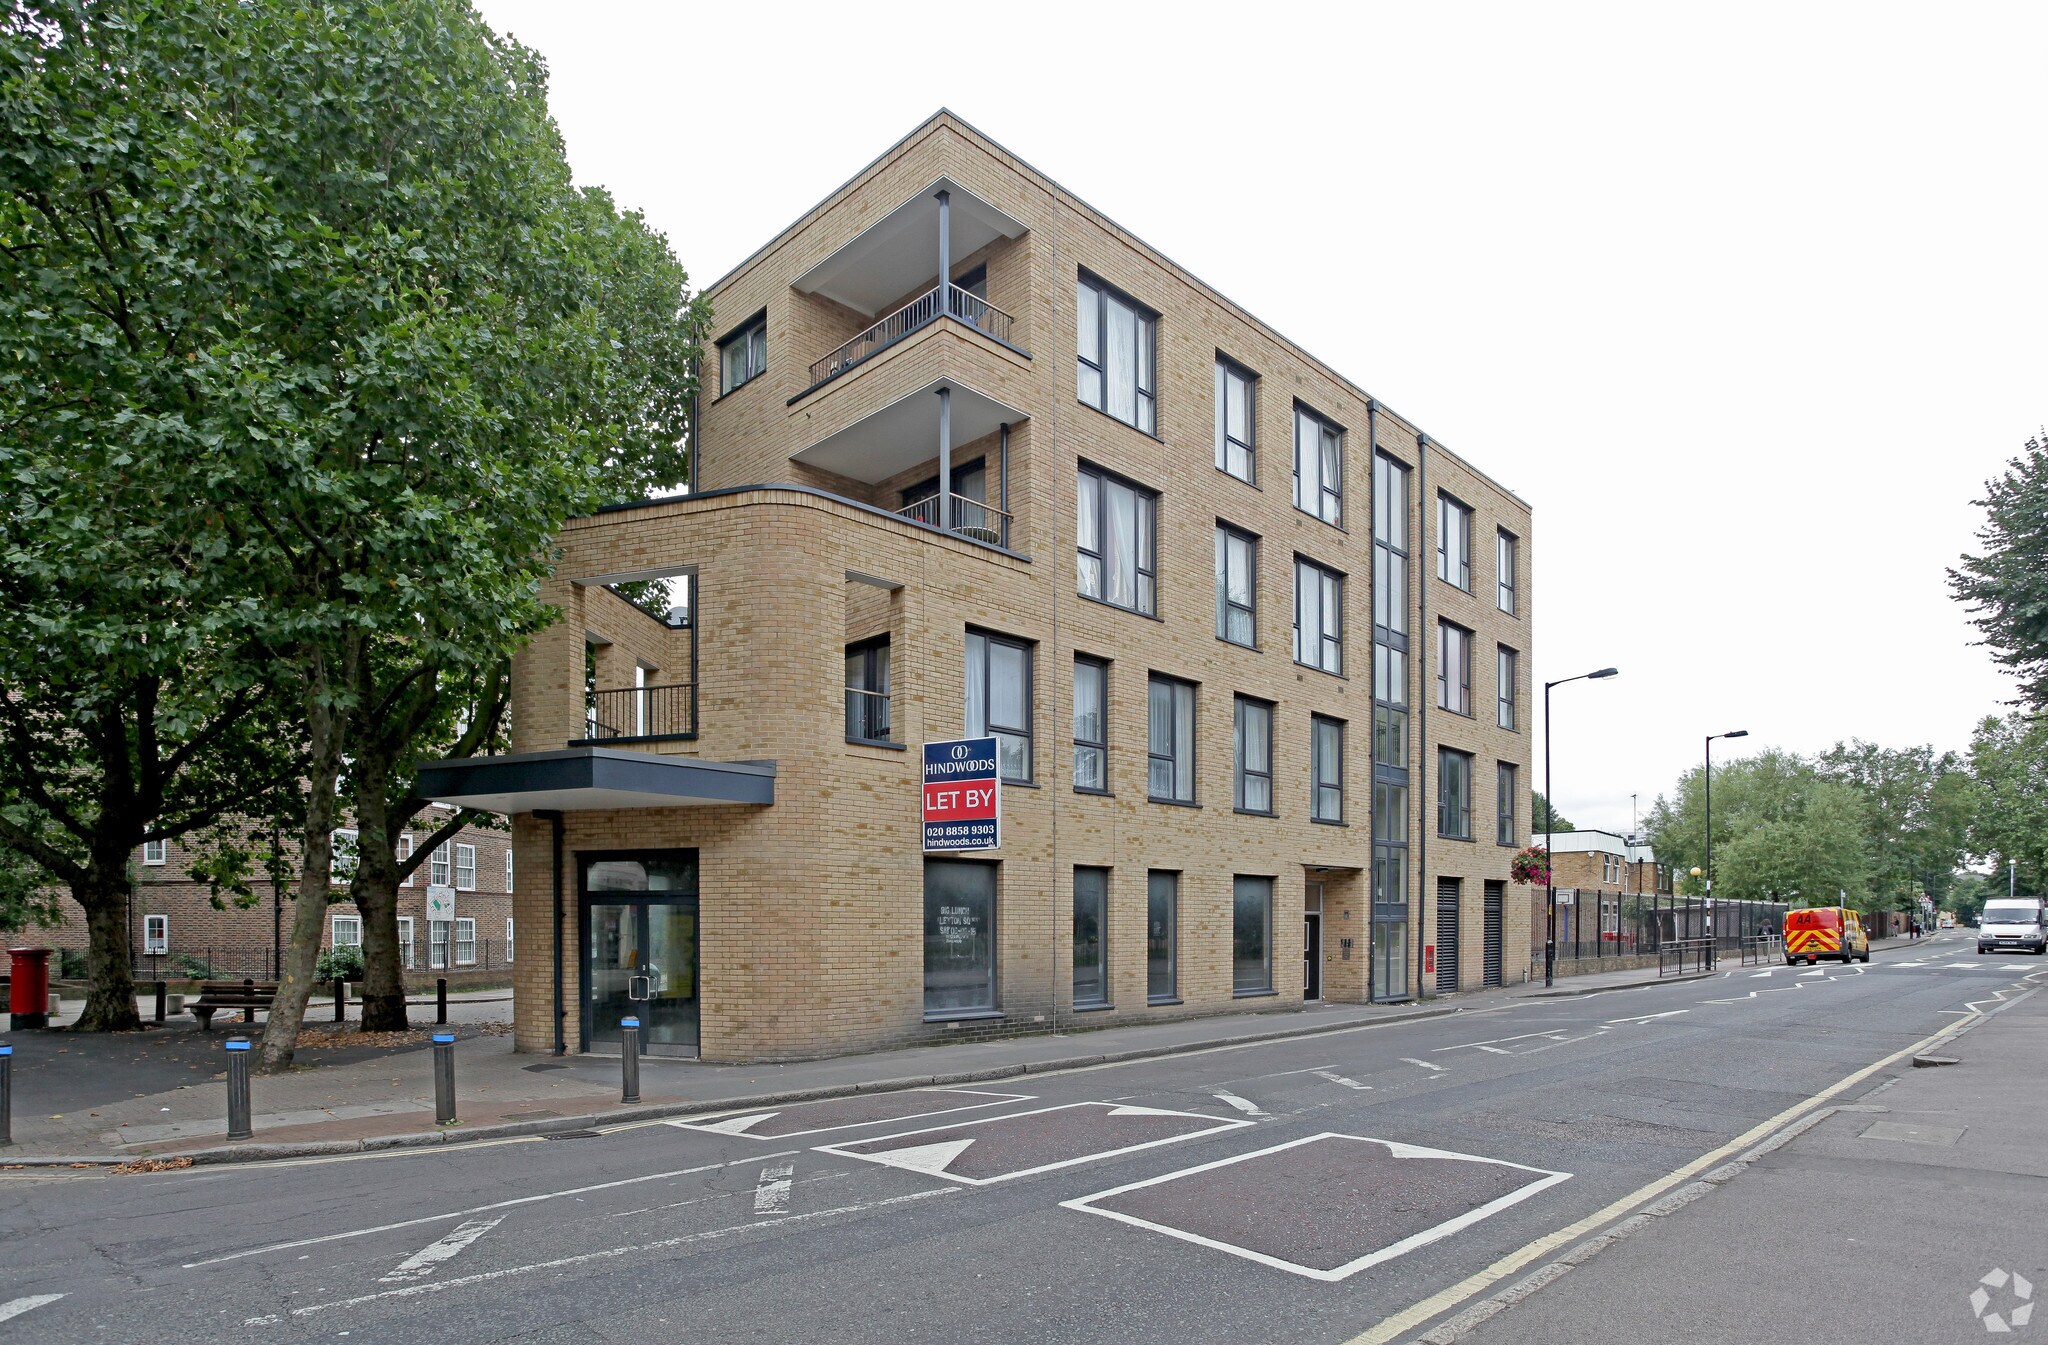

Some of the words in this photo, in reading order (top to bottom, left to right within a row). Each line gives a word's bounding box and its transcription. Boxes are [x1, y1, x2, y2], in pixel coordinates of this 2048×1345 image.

[925, 759, 994, 775] HINDWOODS
[926, 790, 960, 811] LET
[966, 788, 993, 808] BY
[927, 827, 944, 836] 020
[945, 826, 969, 836] 8858
[971, 824, 995, 834] 9303
[927, 836, 994, 847] hindwoods.co.uk
[1796, 915, 1811, 924] AA
